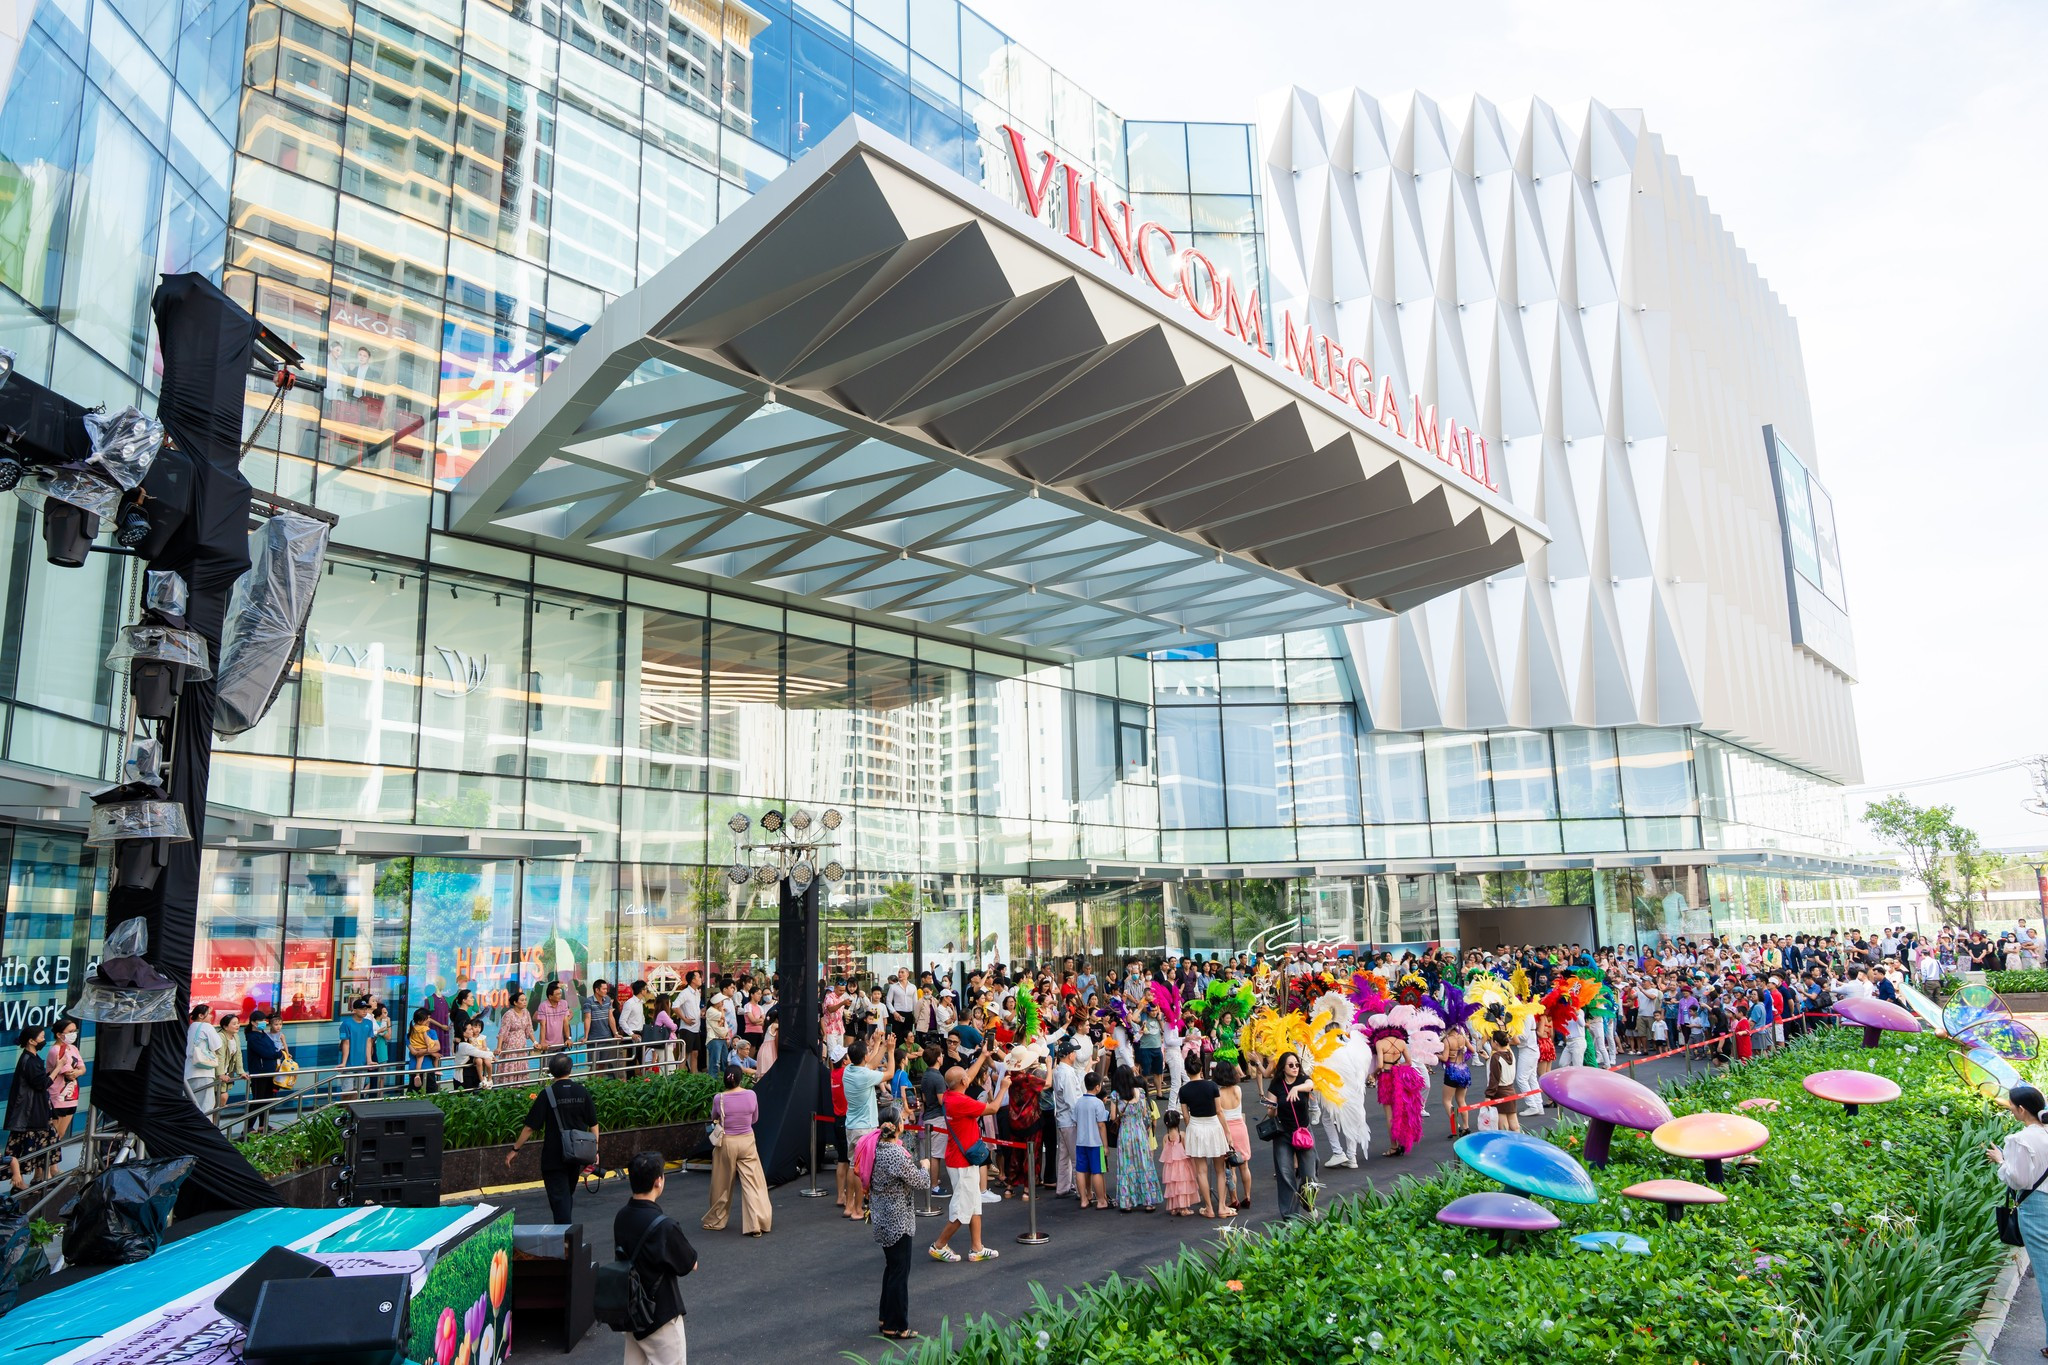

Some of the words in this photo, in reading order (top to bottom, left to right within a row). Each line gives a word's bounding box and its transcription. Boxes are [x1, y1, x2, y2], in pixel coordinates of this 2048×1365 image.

[996, 123, 1272, 358] VINCOM
[1282, 309, 1408, 439] MEGA
[1411, 393, 1499, 494] MALL
[33, 956, 50, 985] &
[456, 945, 545, 981] HAZZYS
